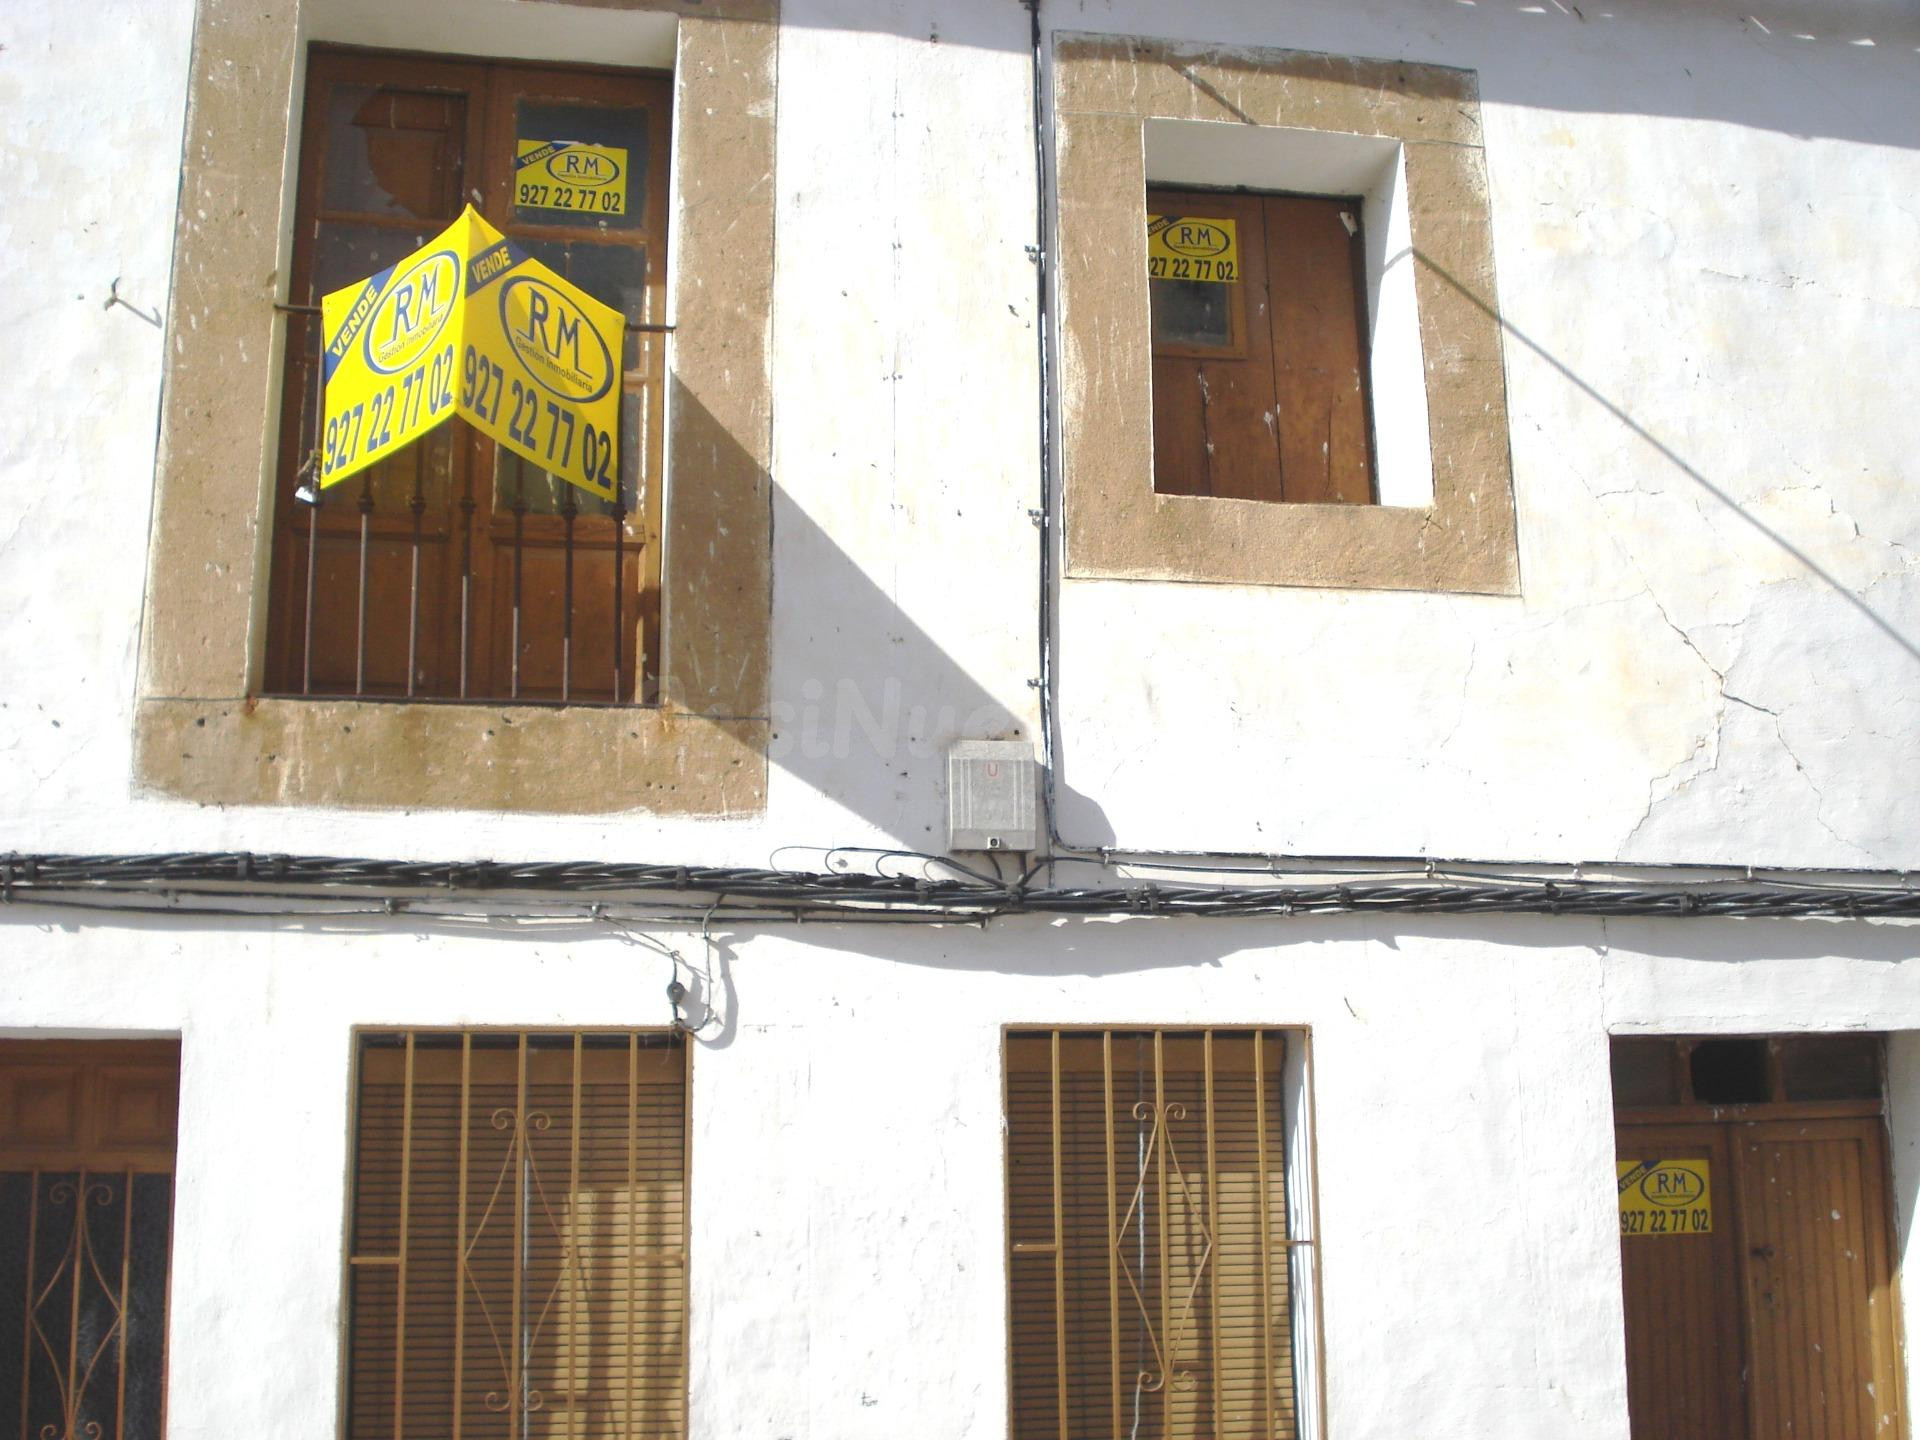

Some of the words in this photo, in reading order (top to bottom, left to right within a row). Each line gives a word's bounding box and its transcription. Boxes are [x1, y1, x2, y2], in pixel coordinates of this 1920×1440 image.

[521, 145, 557, 165] VENDE
[564, 155, 601, 176] RM
[520, 184, 549, 206] 927
[553, 187, 573, 208] 22
[578, 189, 597, 210] 77
[601, 191, 621, 212] 02
[1148, 217, 1169, 233] ENDE
[1179, 226, 1214, 246] RM
[472, 246, 512, 284] VENDE
[1148, 256, 1167, 277] 27
[1172, 258, 1190, 278] 22
[1194, 259, 1211, 280] 77
[1216, 261, 1234, 281] 02
[381, 263, 445, 348] RM
[332, 285, 378, 357] VENDE
[517, 287, 592, 379] RM
[545, 354, 593, 394] Inmobiliaria
[324, 402, 364, 476] 927
[366, 385, 395, 454] 22
[399, 364, 426, 435] 77
[428, 343, 454, 416] 02
[462, 343, 504, 426] 927
[508, 379, 538, 451] 22
[546, 400, 575, 469] 77
[582, 422, 612, 490] 02
[1655, 1172, 1689, 1194] RM
[1621, 1209, 1645, 1233] 927
[1650, 1209, 1666, 1232] 22
[1671, 1209, 1688, 1232] 77
[1692, 1208, 1708, 1231] 02
